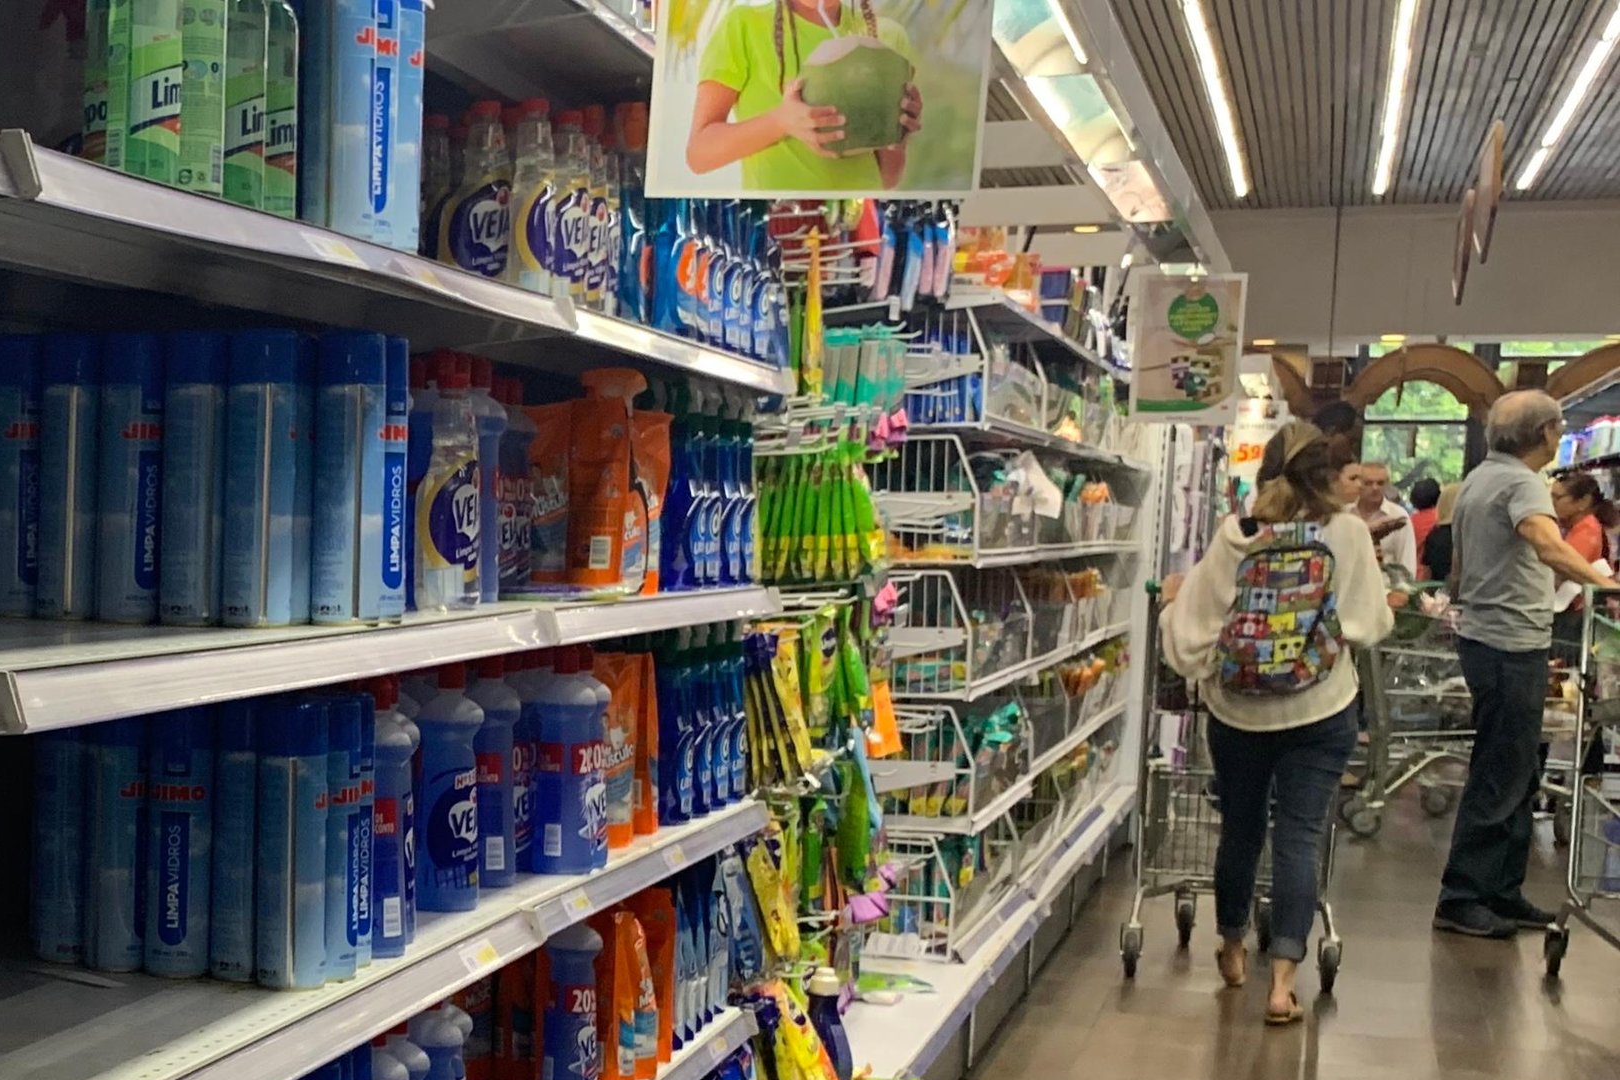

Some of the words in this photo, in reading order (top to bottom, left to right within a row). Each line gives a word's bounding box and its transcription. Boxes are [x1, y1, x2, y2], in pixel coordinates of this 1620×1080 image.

[143, 464, 158, 572] LIMPAVIDROS
[390, 465, 403, 573] LIMPAVIDROS
[166, 824, 182, 929] LIMPAVIDROS
[359, 817, 371, 920] LIMPAVIDROS
